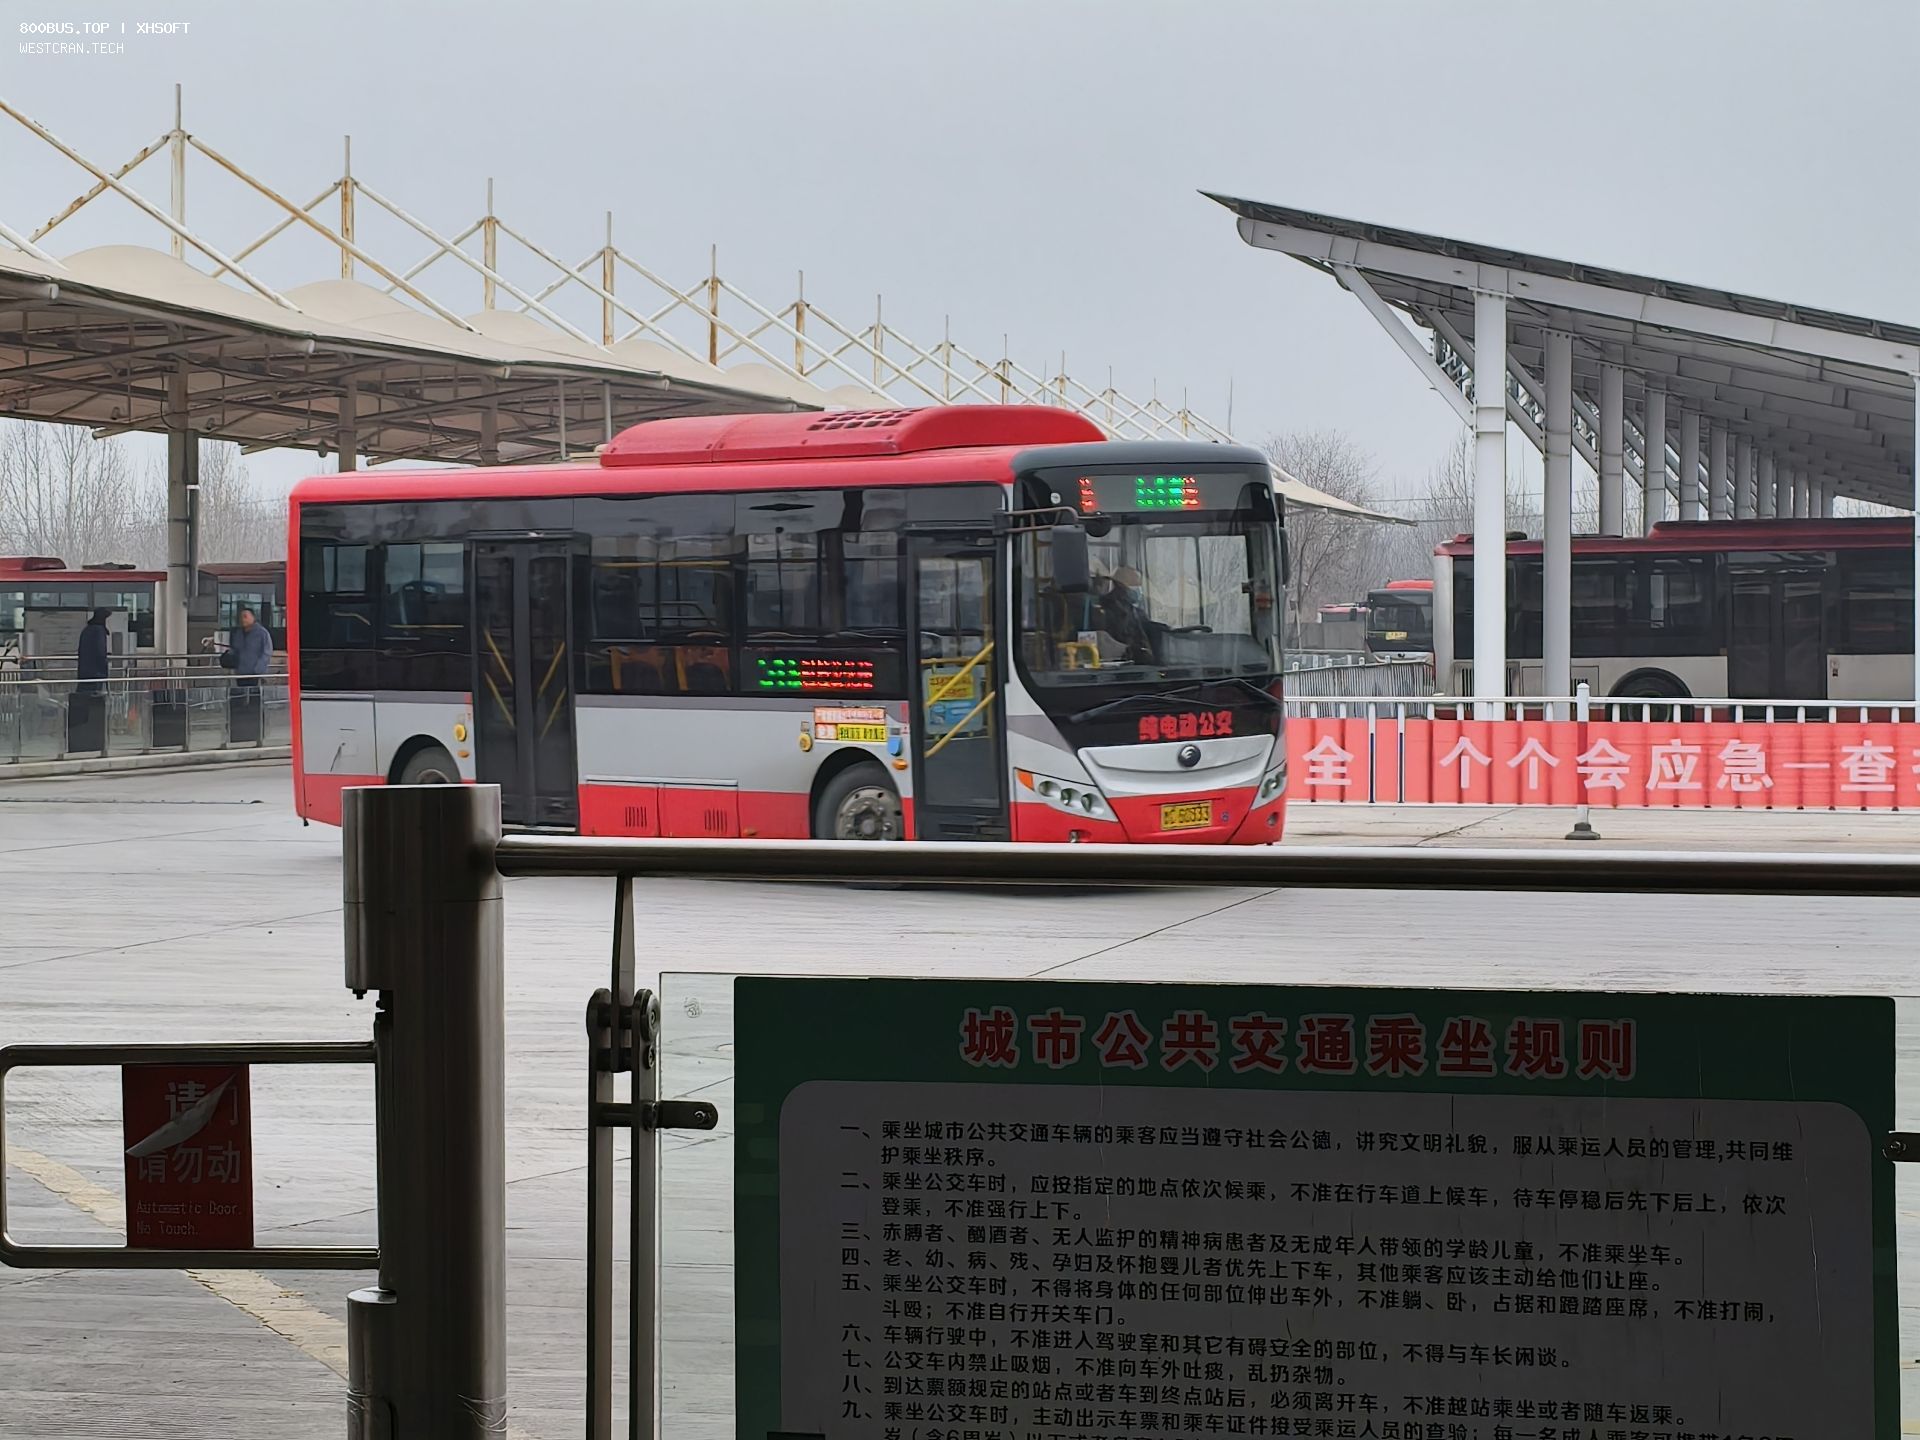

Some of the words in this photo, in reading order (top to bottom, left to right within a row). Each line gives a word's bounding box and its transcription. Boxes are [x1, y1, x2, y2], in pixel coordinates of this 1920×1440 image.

[960, 1008, 1637, 1080] 城市公共交通乘坐规则
[881, 1146, 997, 1168] 护乘坐秩序。
